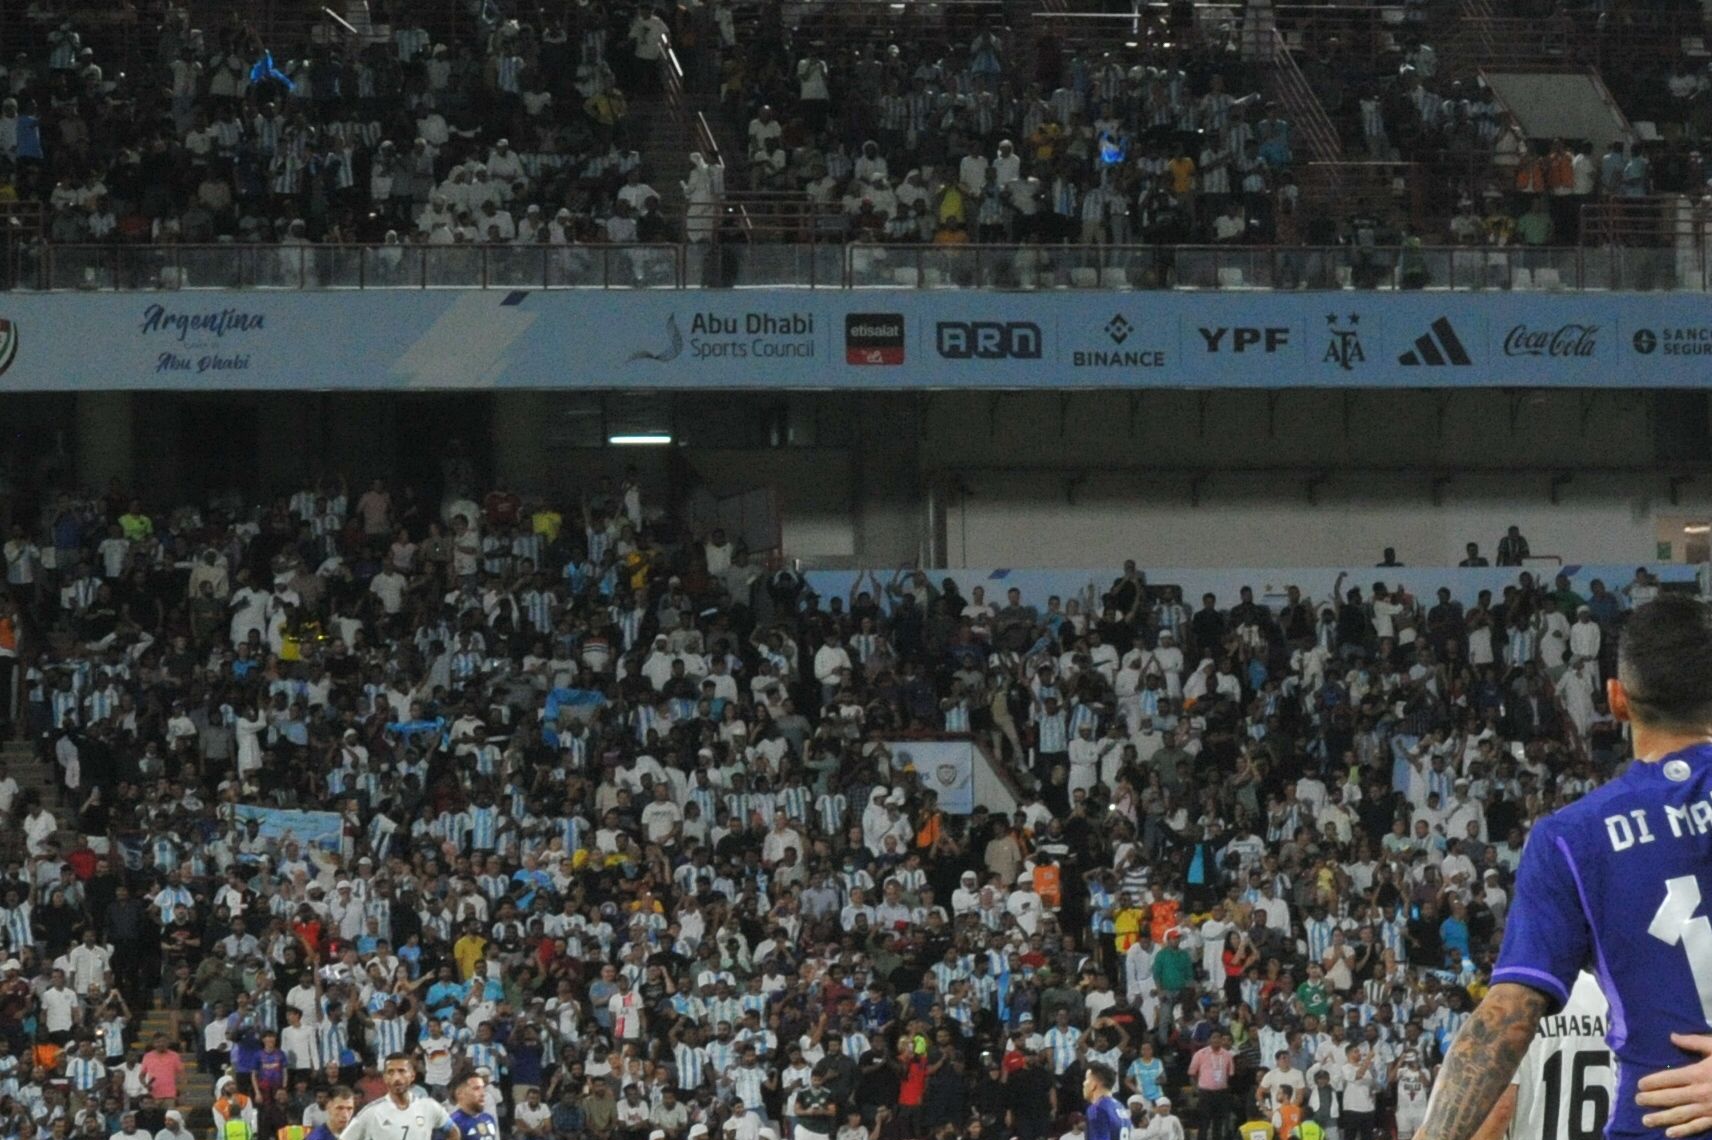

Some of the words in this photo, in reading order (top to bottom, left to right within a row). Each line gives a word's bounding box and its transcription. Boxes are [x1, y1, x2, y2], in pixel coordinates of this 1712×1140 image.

[141, 303, 265, 341] Argentina
[691, 313, 738, 335] Abu
[746, 312, 814, 335] Dhabi
[690, 337, 748, 359] Sports
[752, 336, 815, 358] Council
[1198, 327, 1290, 352] YPF
[155, 352, 192, 374] Abu
[196, 354, 250, 375] Dhabi
[1073, 351, 1165, 367] BINANCE
[1605, 809, 1655, 852] DI
